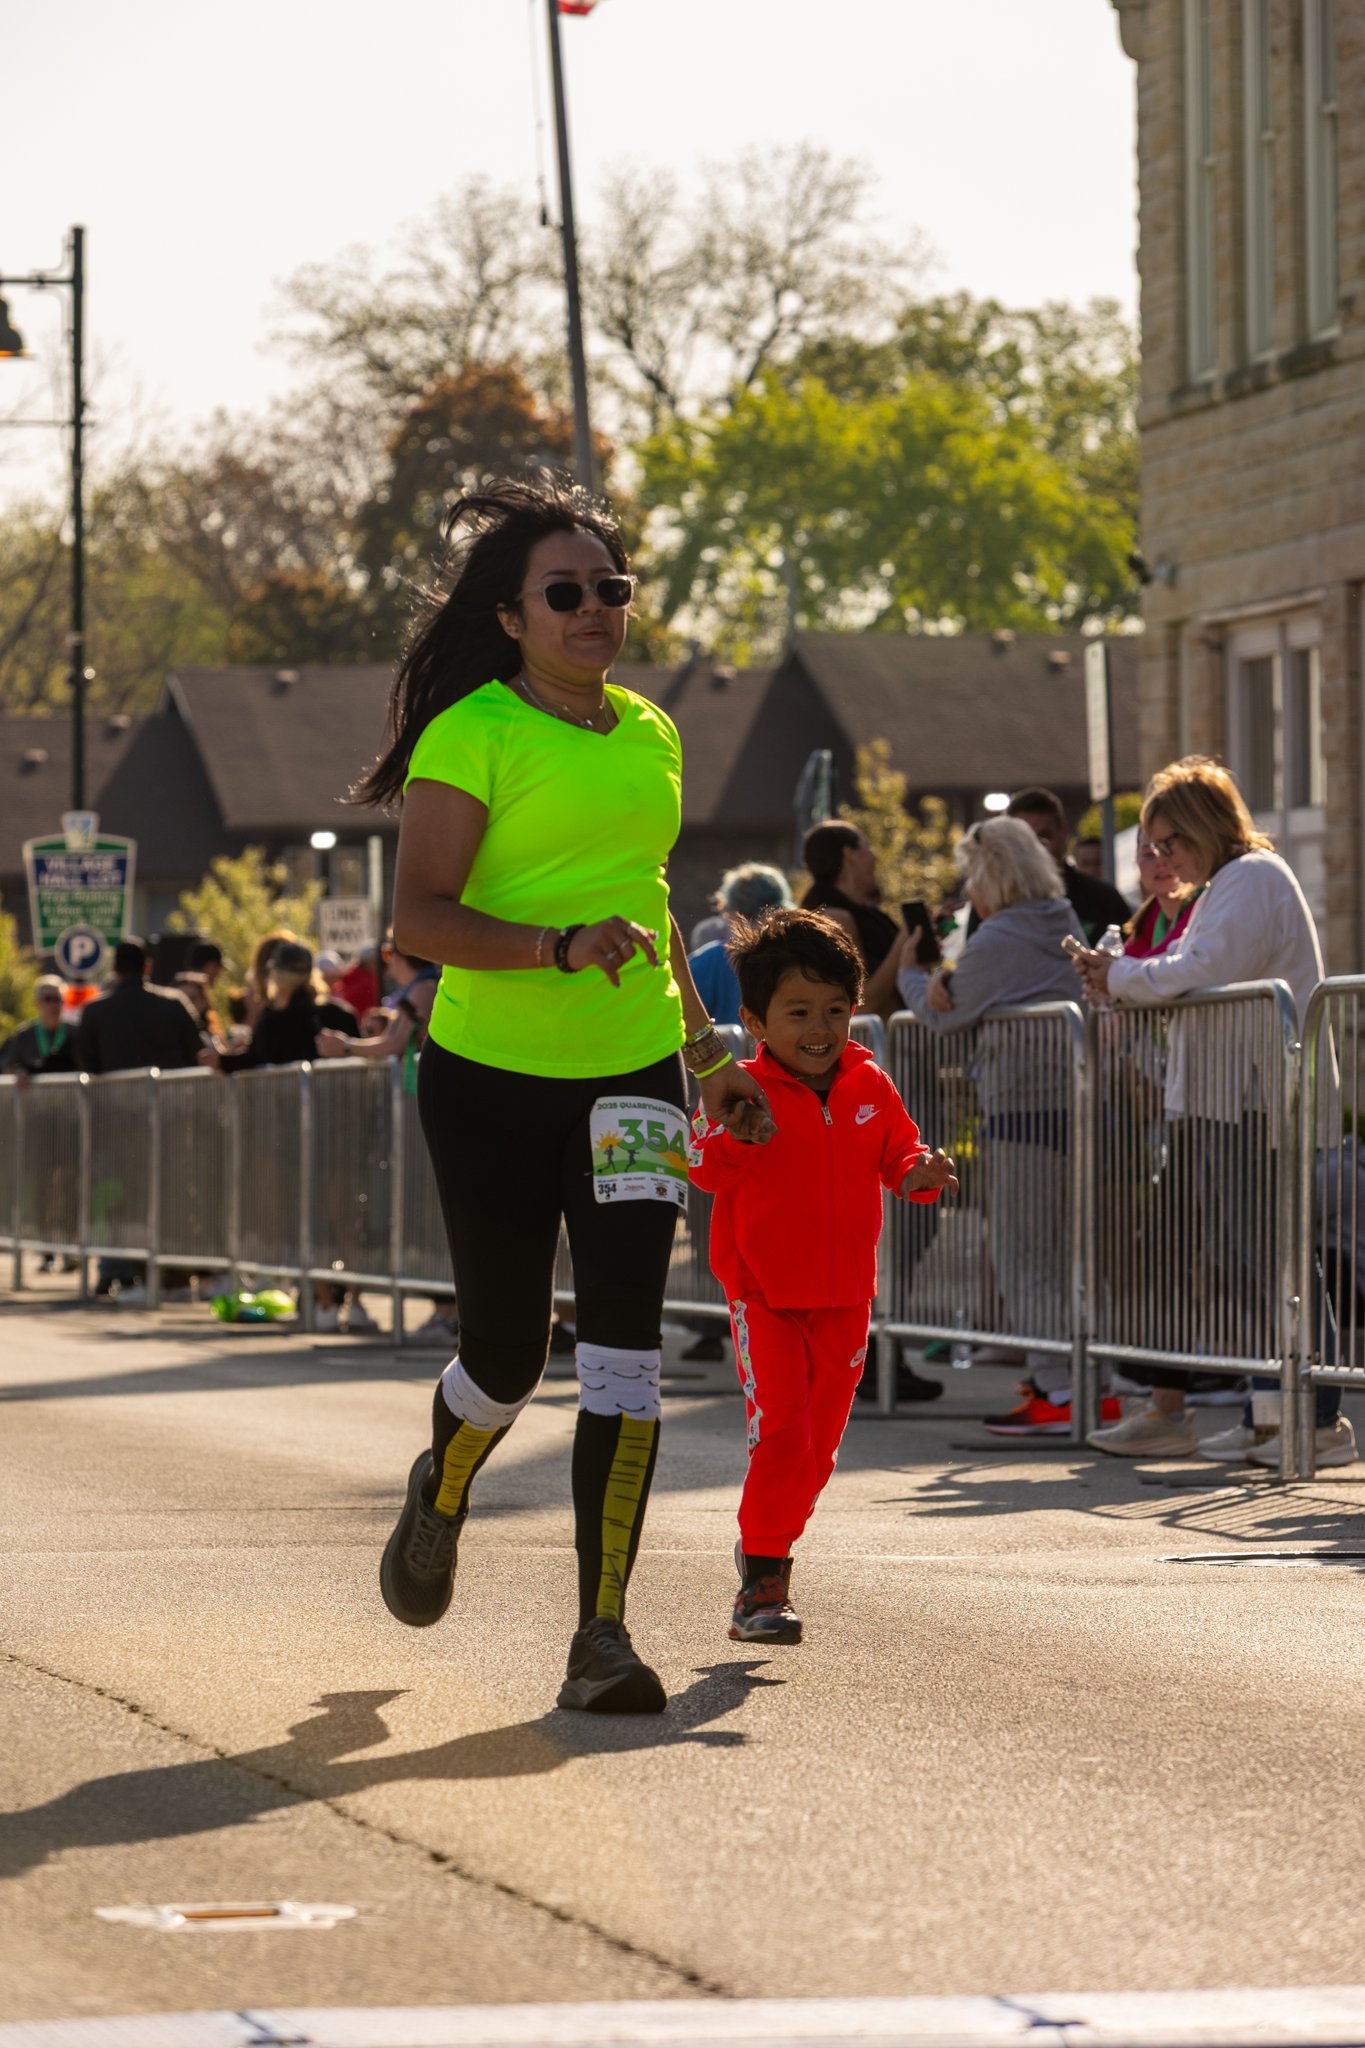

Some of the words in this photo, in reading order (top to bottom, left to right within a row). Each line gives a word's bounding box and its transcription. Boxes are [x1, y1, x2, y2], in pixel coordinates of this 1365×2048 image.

[45, 855, 115, 870] VILLAGE
[38, 871, 80, 888] HALL
[87, 871, 122, 888] LOT
[327, 906, 361, 921] ONE
[328, 927, 364, 943] WAY
[70, 935, 96, 966] P
[620, 1102, 667, 1114] QUARRYMAN
[858, 1104, 875, 1117] NIKE
[618, 1119, 687, 1162] 354
[598, 1183, 616, 1194] 354
